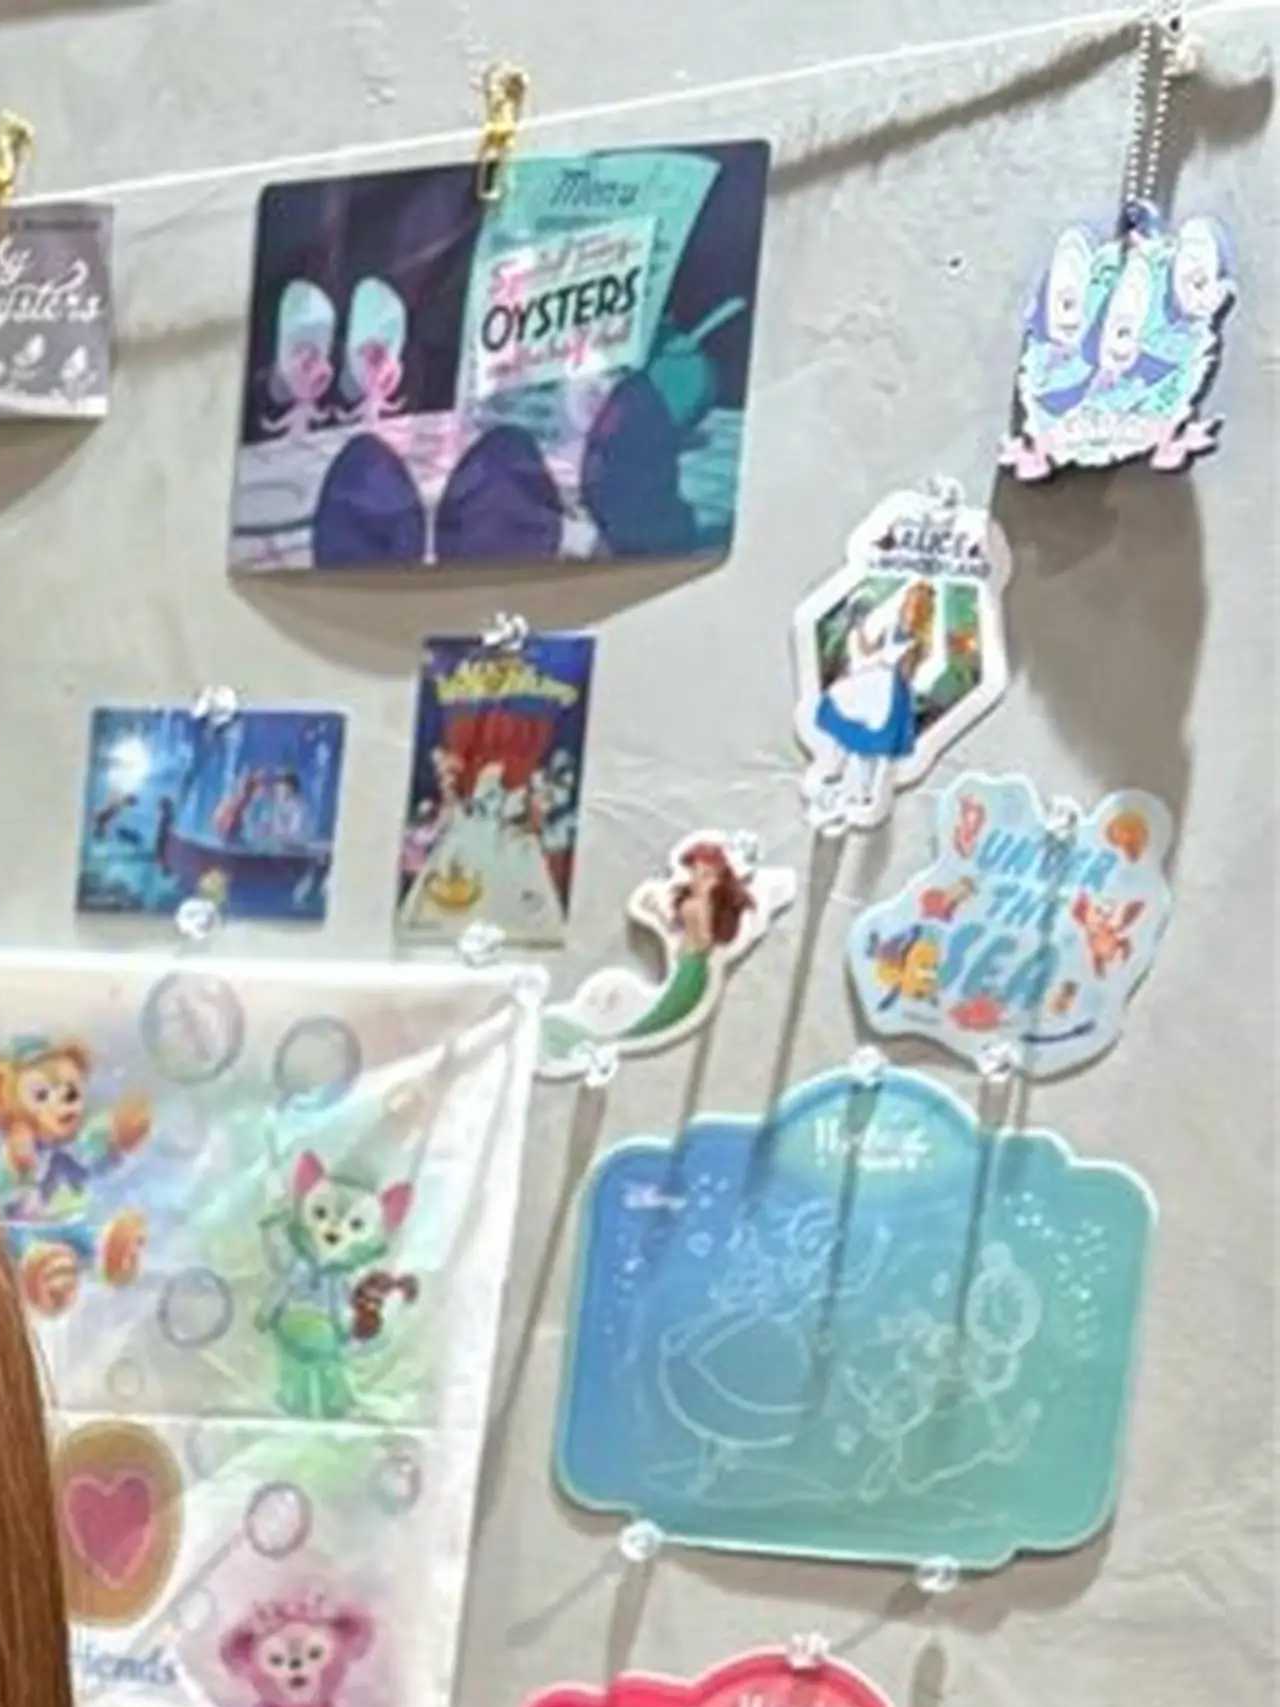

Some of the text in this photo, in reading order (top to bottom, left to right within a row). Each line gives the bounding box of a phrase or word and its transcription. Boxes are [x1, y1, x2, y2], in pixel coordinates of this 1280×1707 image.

[481, 267, 641, 351] OYSTERS
[974, 828, 1120, 892] UNDER
[936, 922, 1062, 1010] SEA
